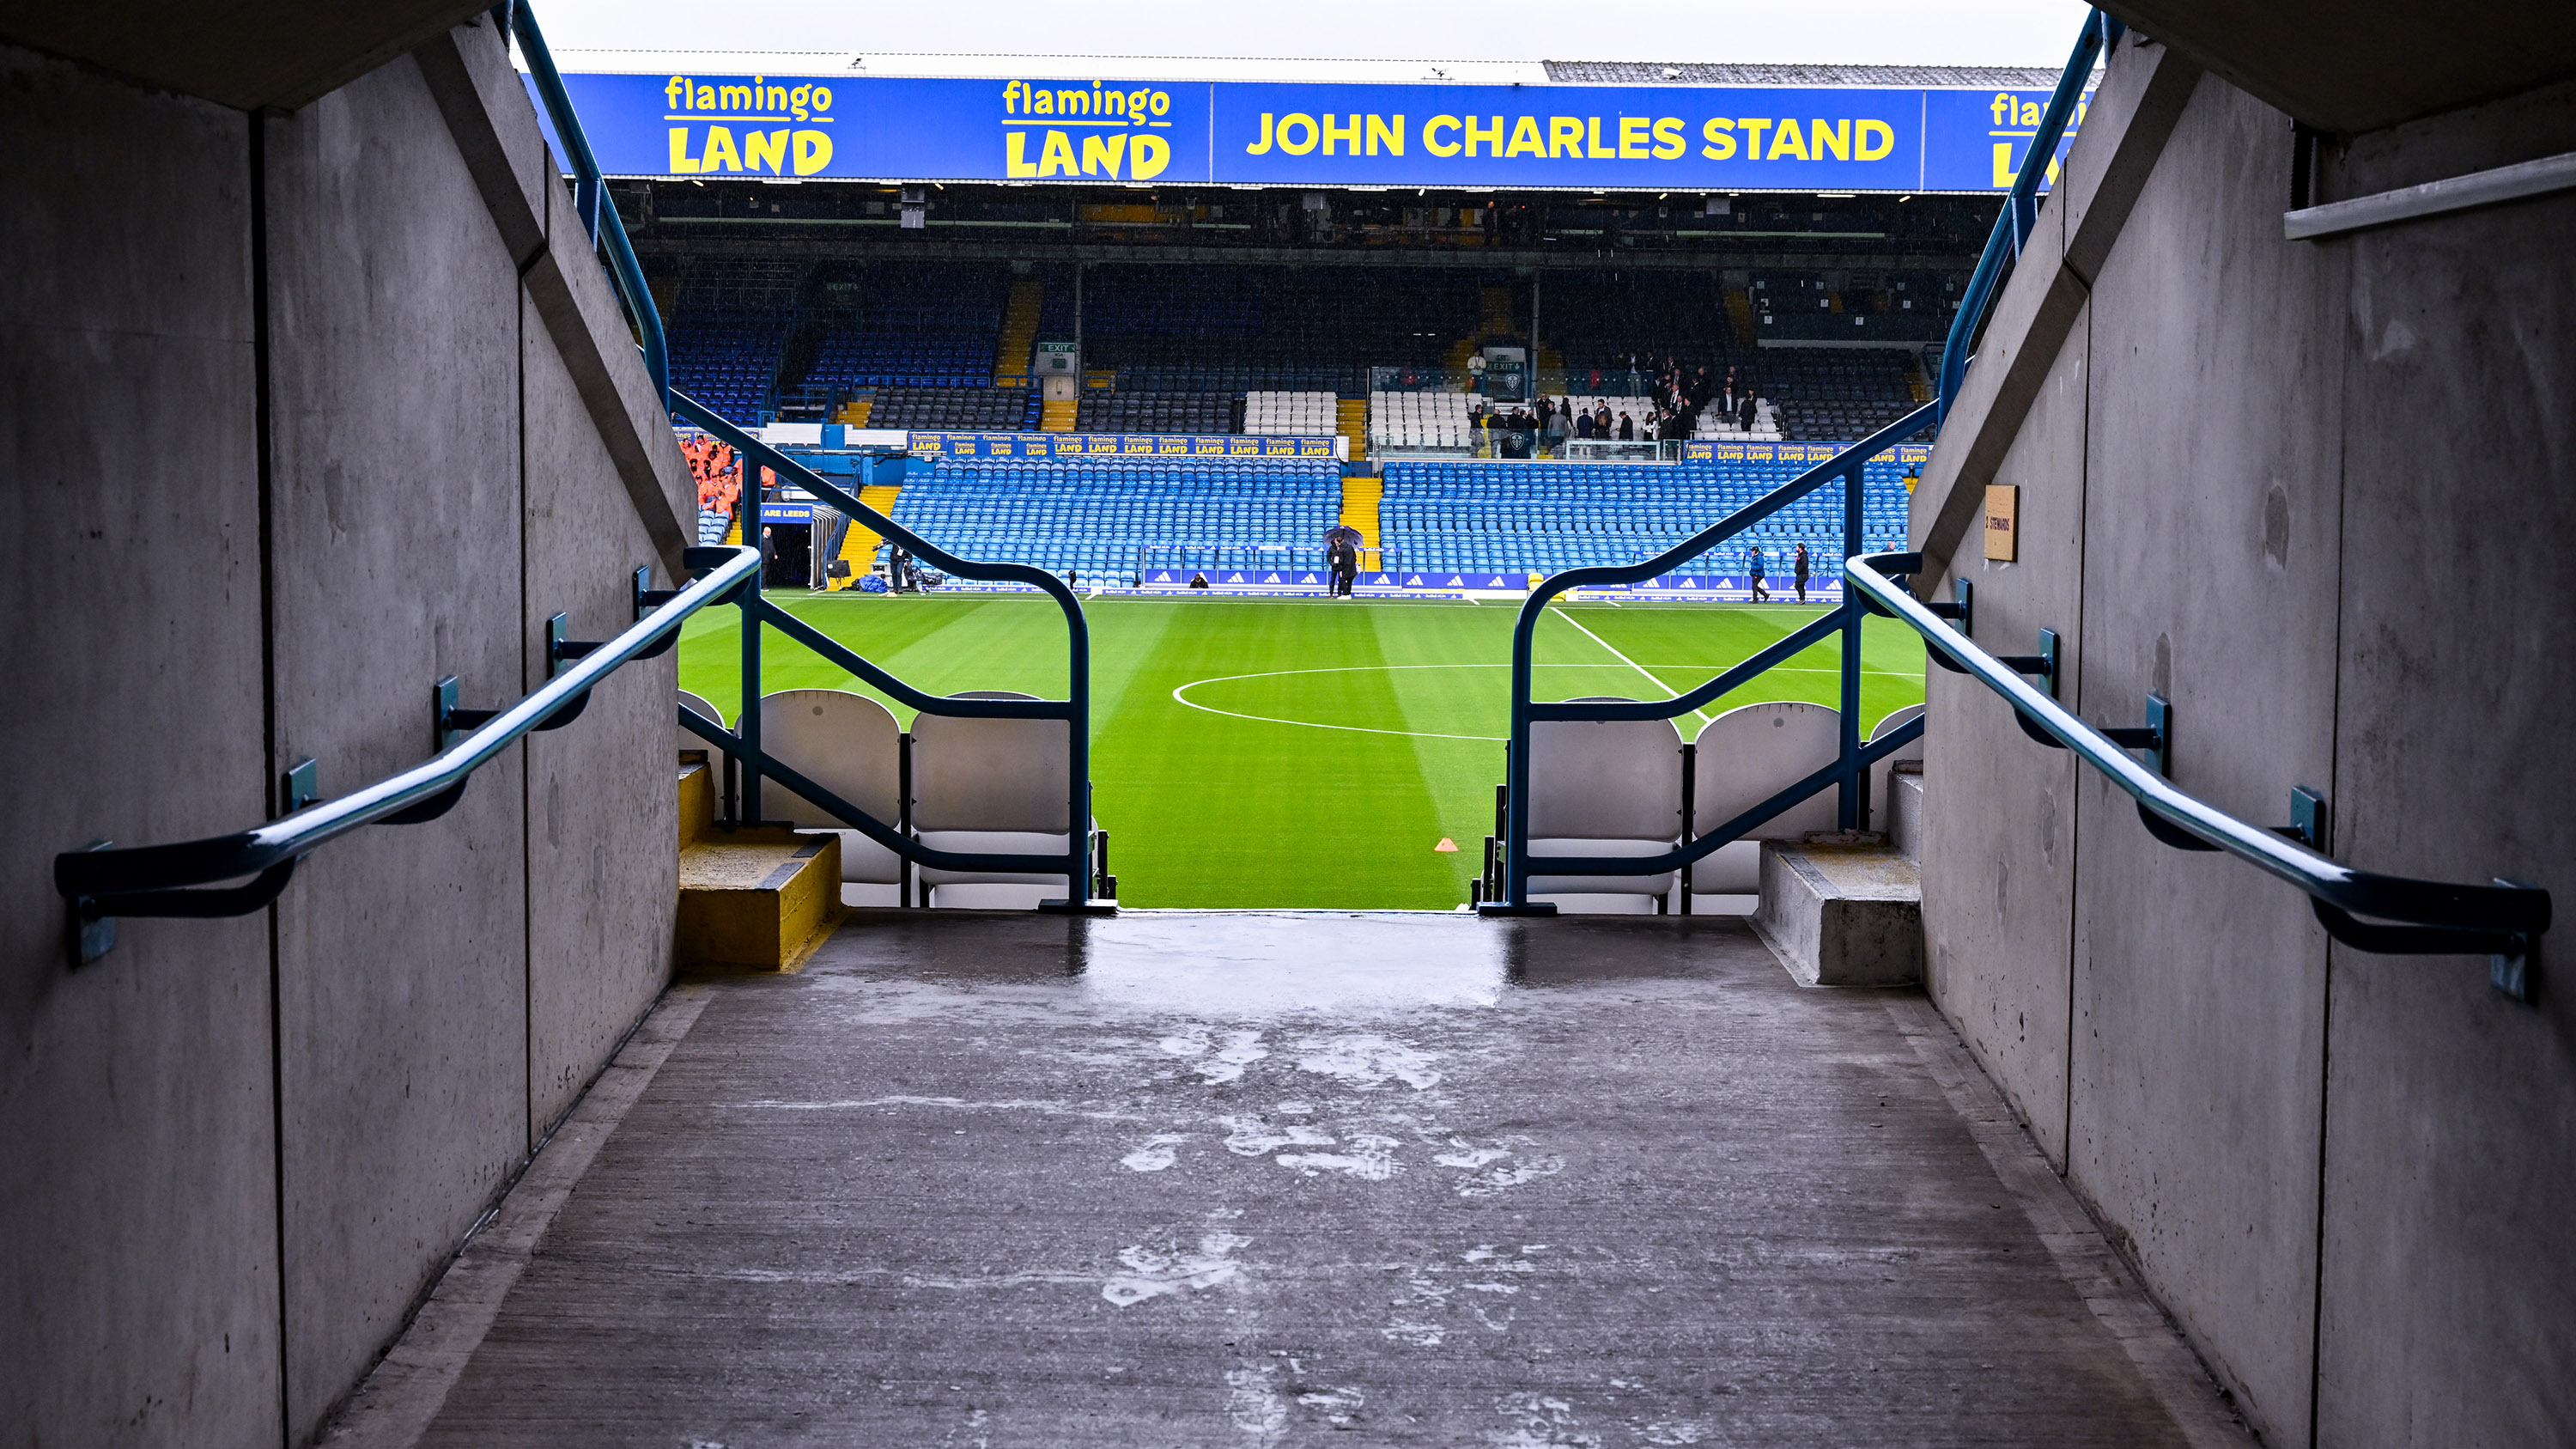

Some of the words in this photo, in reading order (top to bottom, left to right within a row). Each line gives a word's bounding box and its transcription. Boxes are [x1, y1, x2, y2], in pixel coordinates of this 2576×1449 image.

[665, 76, 833, 121] flamingo
[1003, 80, 1170, 125] flamingo
[1247, 113, 1405, 156] JOHN
[1424, 114, 1687, 160] CHARLES
[1703, 118, 1894, 161] STAND
[670, 125, 833, 177] LAND
[1006, 129, 1171, 180] LAND
[1088, 435, 1117, 444] flamingo
[1159, 436, 1188, 445] flamingo
[1230, 437, 1259, 446] flamingo
[1301, 438, 1329, 447] flamingo
[913, 442, 941, 451] LAND
[1054, 444, 1083, 453] LAND
[1089, 444, 1117, 453] LAND
[1125, 445, 1153, 454] LAND
[1160, 445, 1188, 454] LAND
[1196, 446, 1224, 454] LAND
[1230, 446, 1259, 455] LAND
[1267, 447, 1295, 455] LAND
[1301, 447, 1329, 456] LAND
[1686, 451, 1712, 460] LAND
[1747, 452, 1772, 460] LAND
[1990, 516, 2009, 531] STEWARDS
